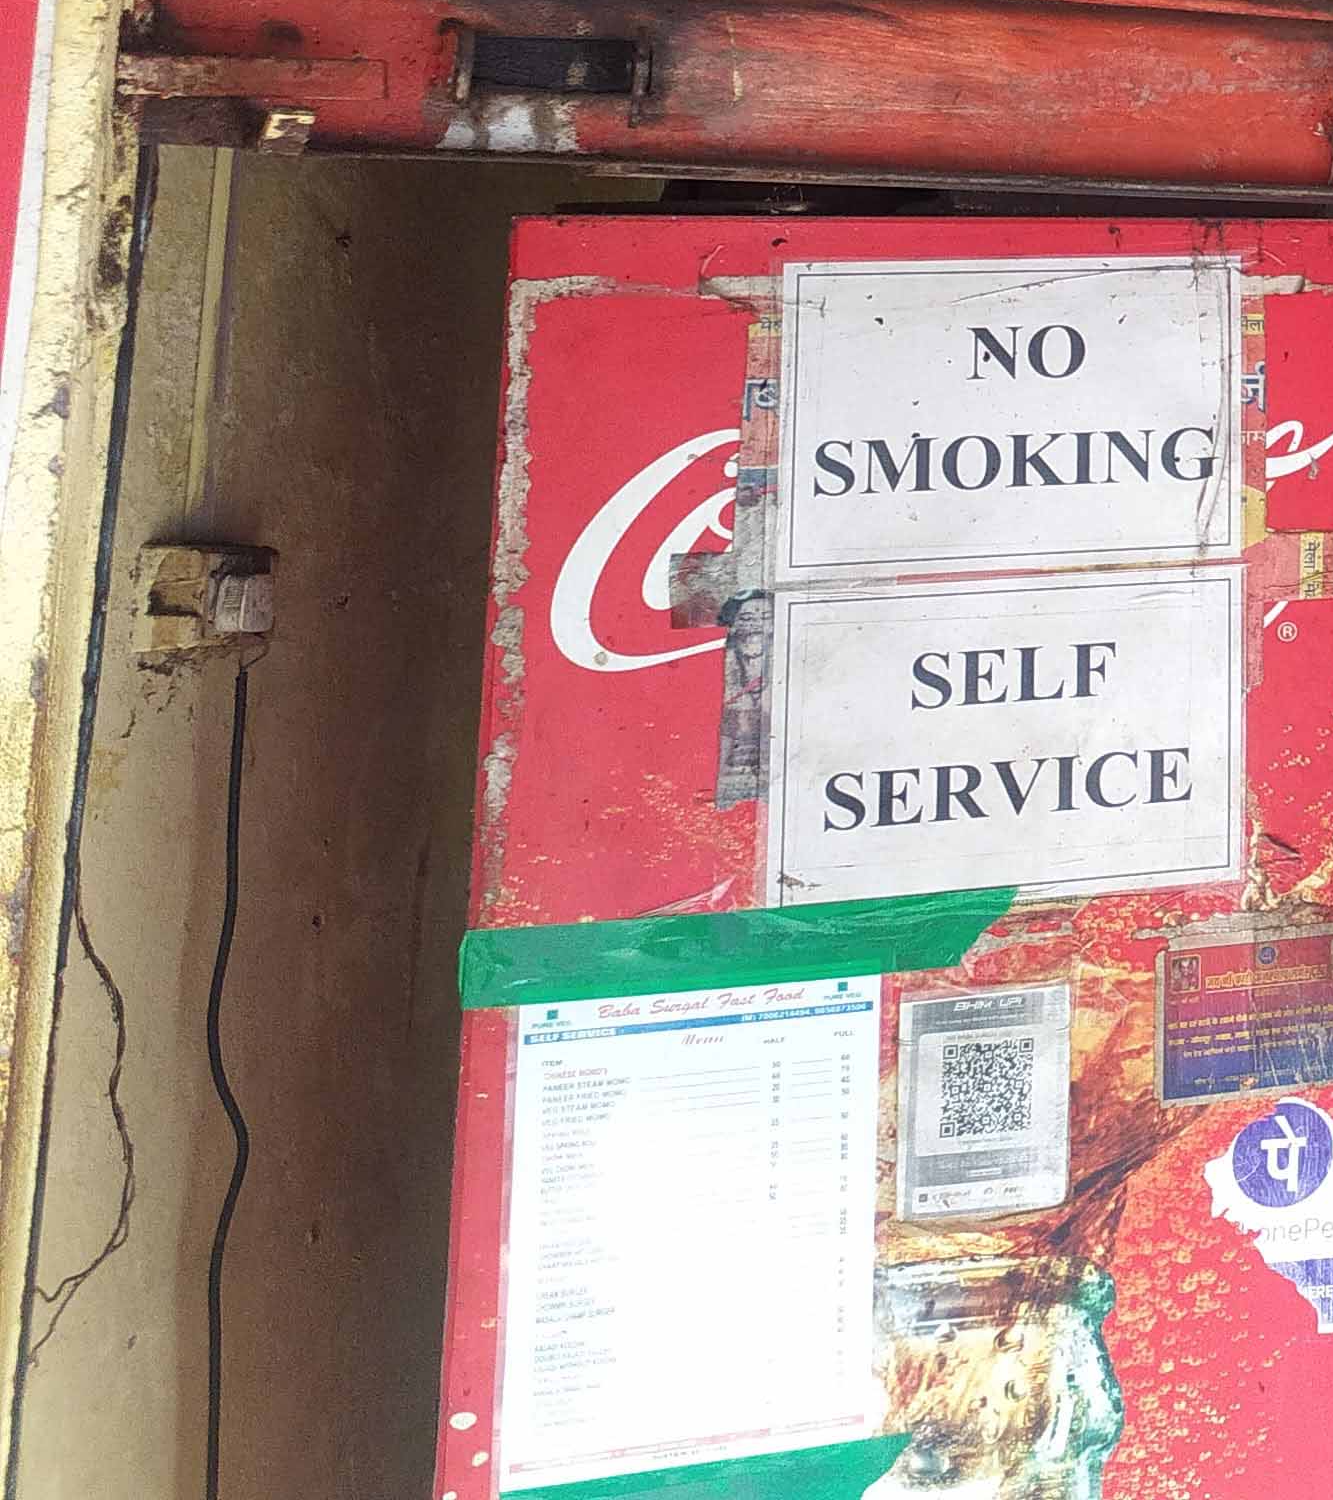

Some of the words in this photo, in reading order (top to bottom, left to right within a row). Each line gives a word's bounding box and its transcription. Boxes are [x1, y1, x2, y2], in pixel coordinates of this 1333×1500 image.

[967, 324, 1087, 381] NO
[813, 425, 1217, 498] SMOKING
[909, 640, 1117, 710] SELF
[823, 746, 1193, 832] SERVICE
[529, 1032, 560, 1044] SELF
[560, 1027, 617, 1041] SERVICE
[597, 1003, 641, 1019] Baba
[649, 996, 709, 1015] Surgal
[717, 992, 755, 1010] Fast
[763, 987, 805, 1005] Food
[1260, 1115, 1308, 1193] पे
